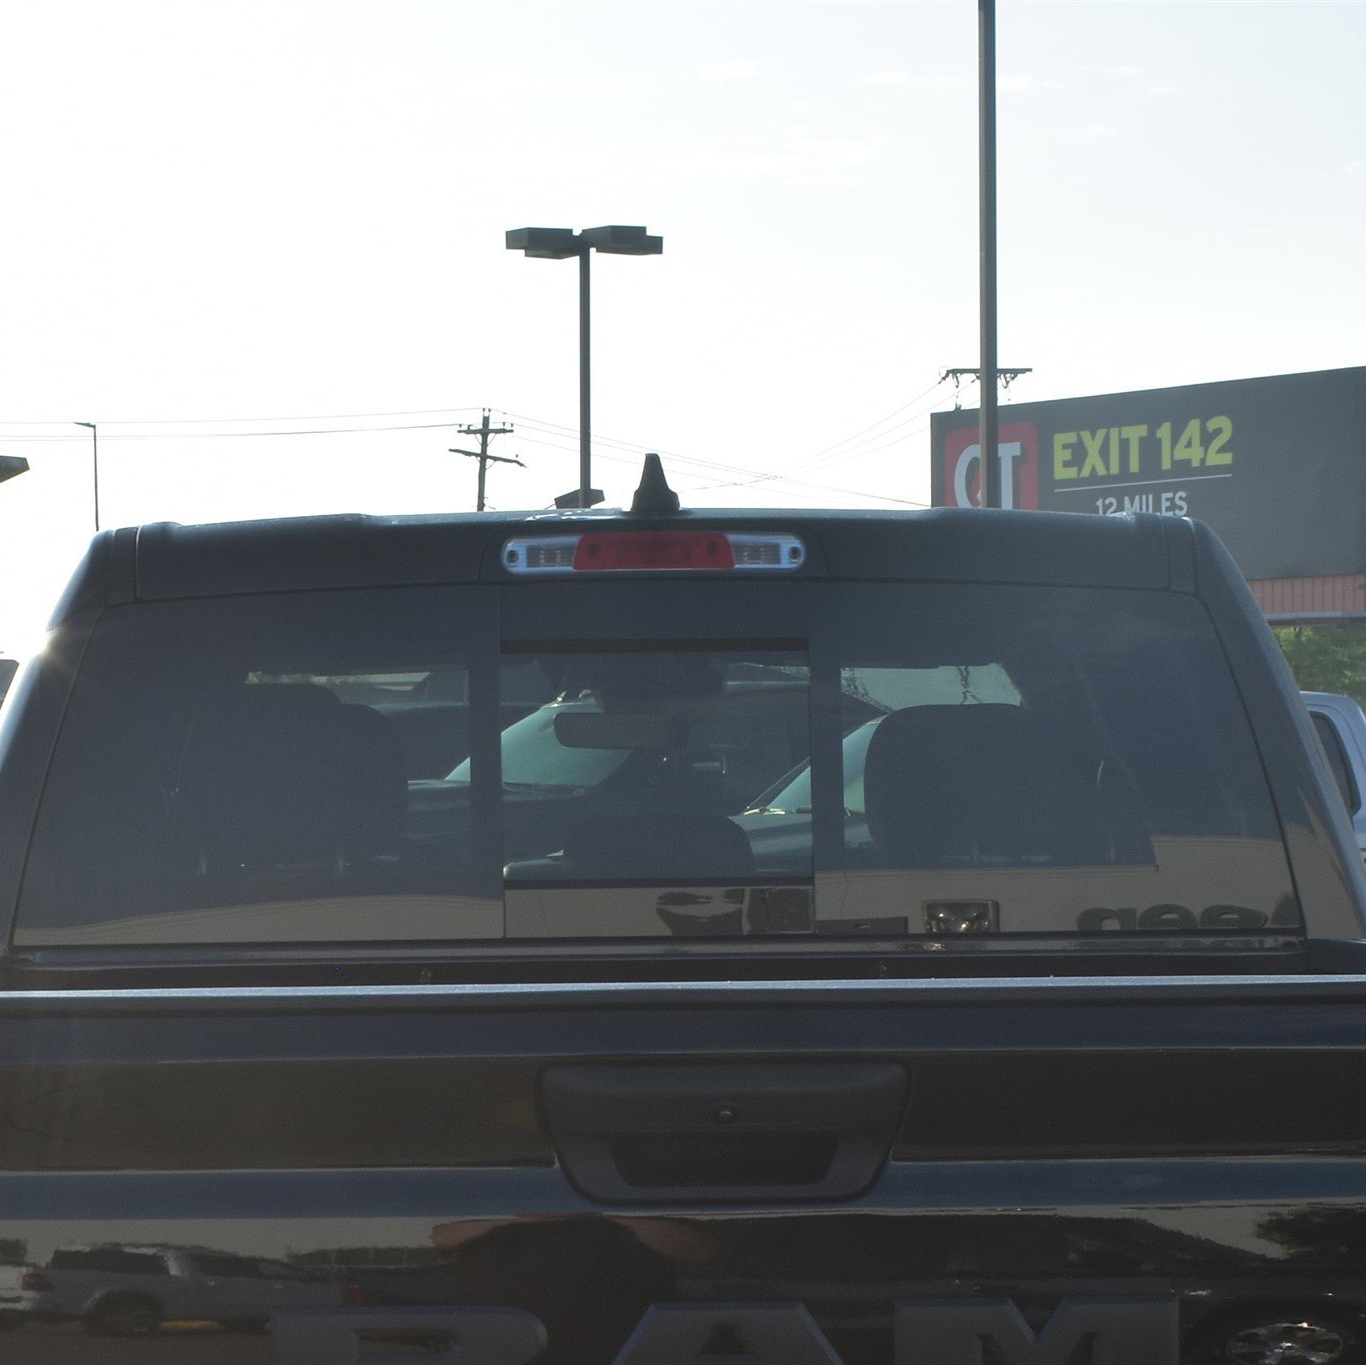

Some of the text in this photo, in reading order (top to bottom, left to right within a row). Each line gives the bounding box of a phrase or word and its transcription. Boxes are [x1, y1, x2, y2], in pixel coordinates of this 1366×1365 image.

[1053, 415, 1233, 480] EXIT 142
[1096, 491, 1188, 517] 12 MILES
